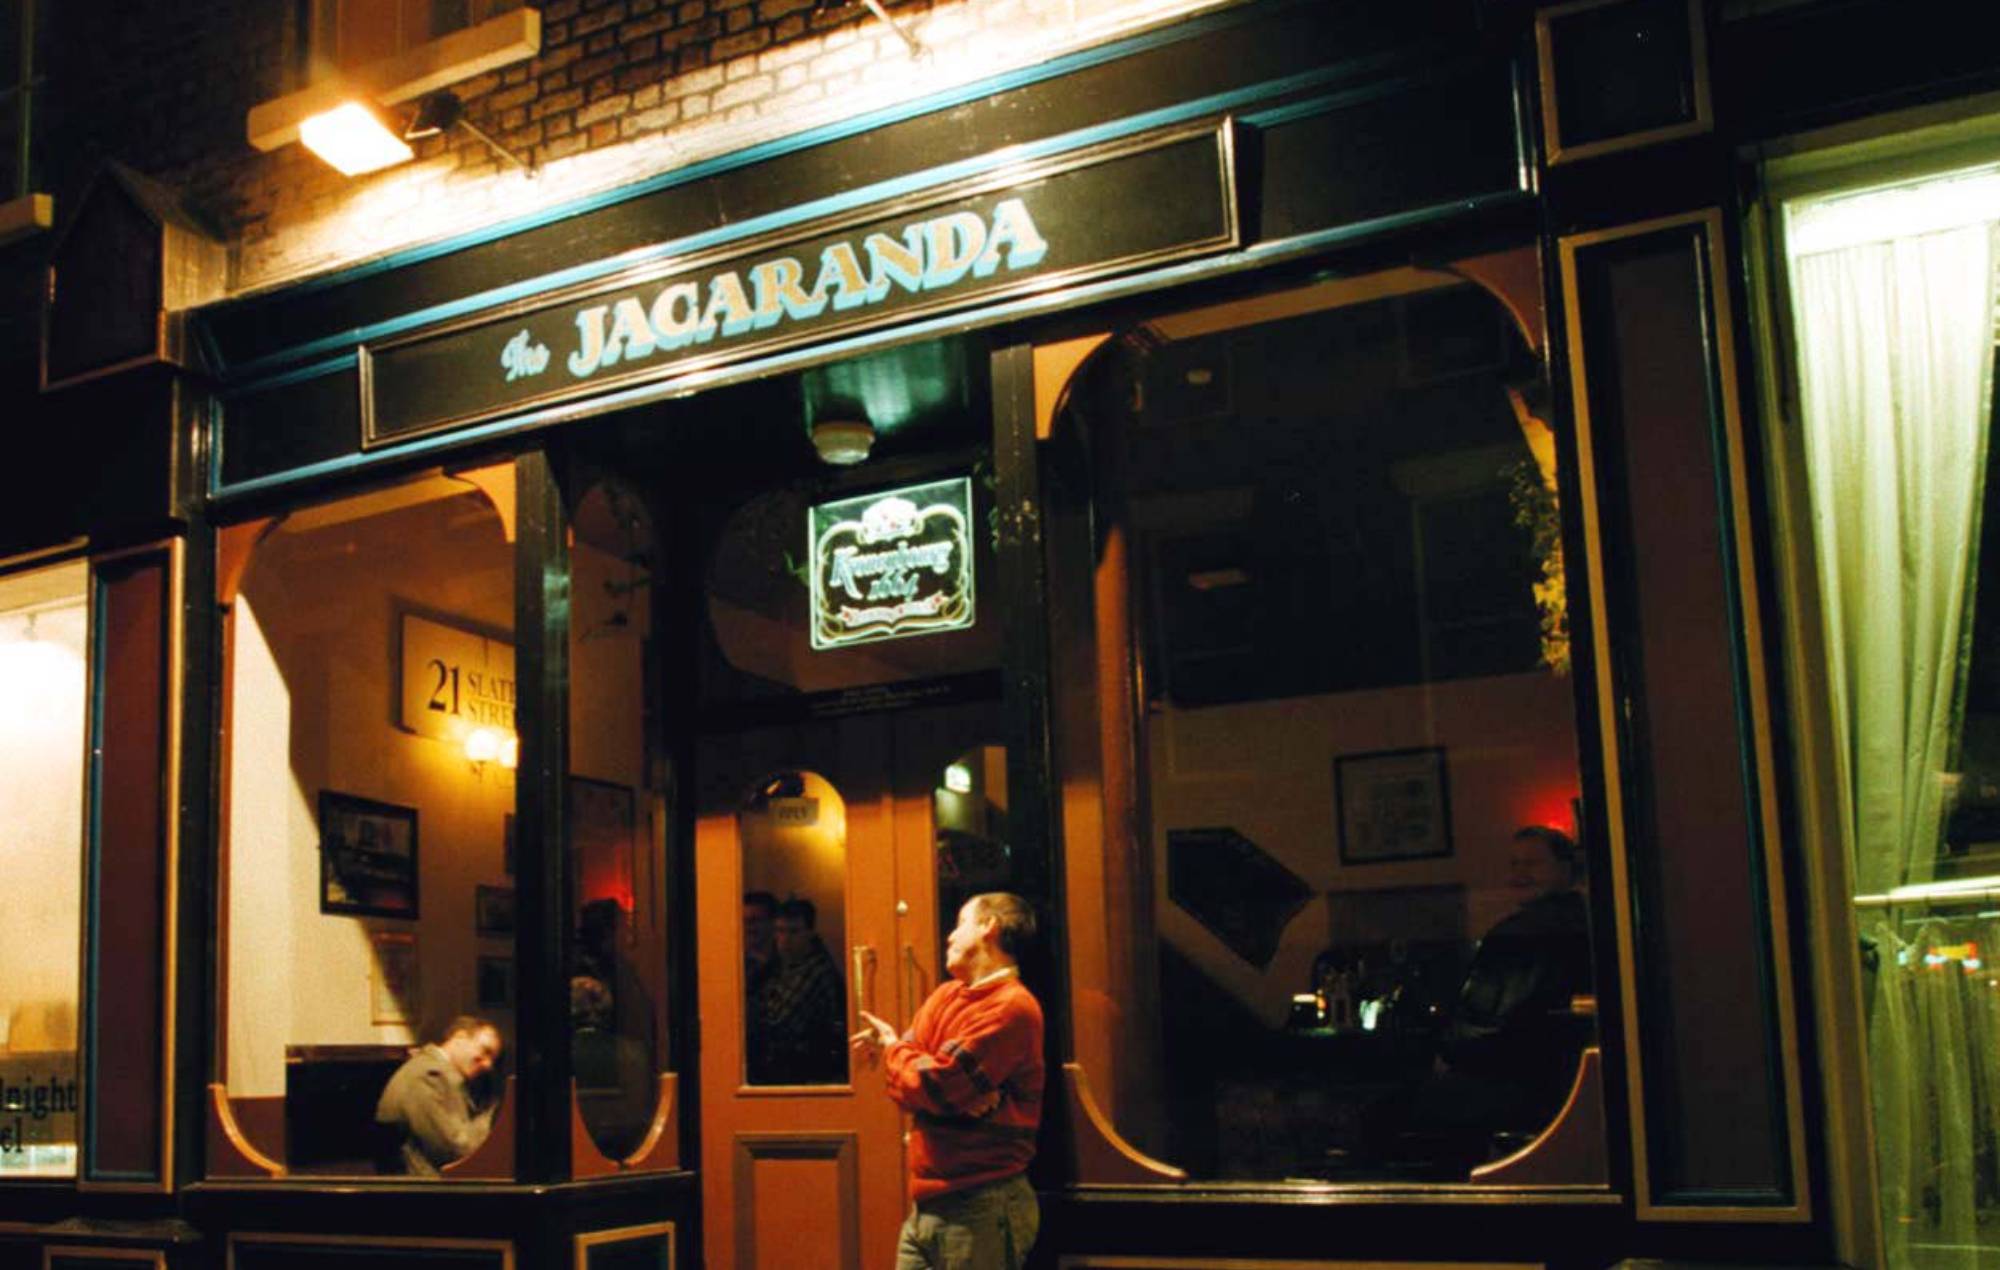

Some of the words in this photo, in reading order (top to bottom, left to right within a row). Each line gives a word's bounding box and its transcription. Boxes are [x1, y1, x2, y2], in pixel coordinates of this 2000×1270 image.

[501, 328, 551, 382] The
[568, 197, 1049, 377] JACARANDA
[427, 658, 460, 715] 21
[467, 698, 516, 729] STRE
